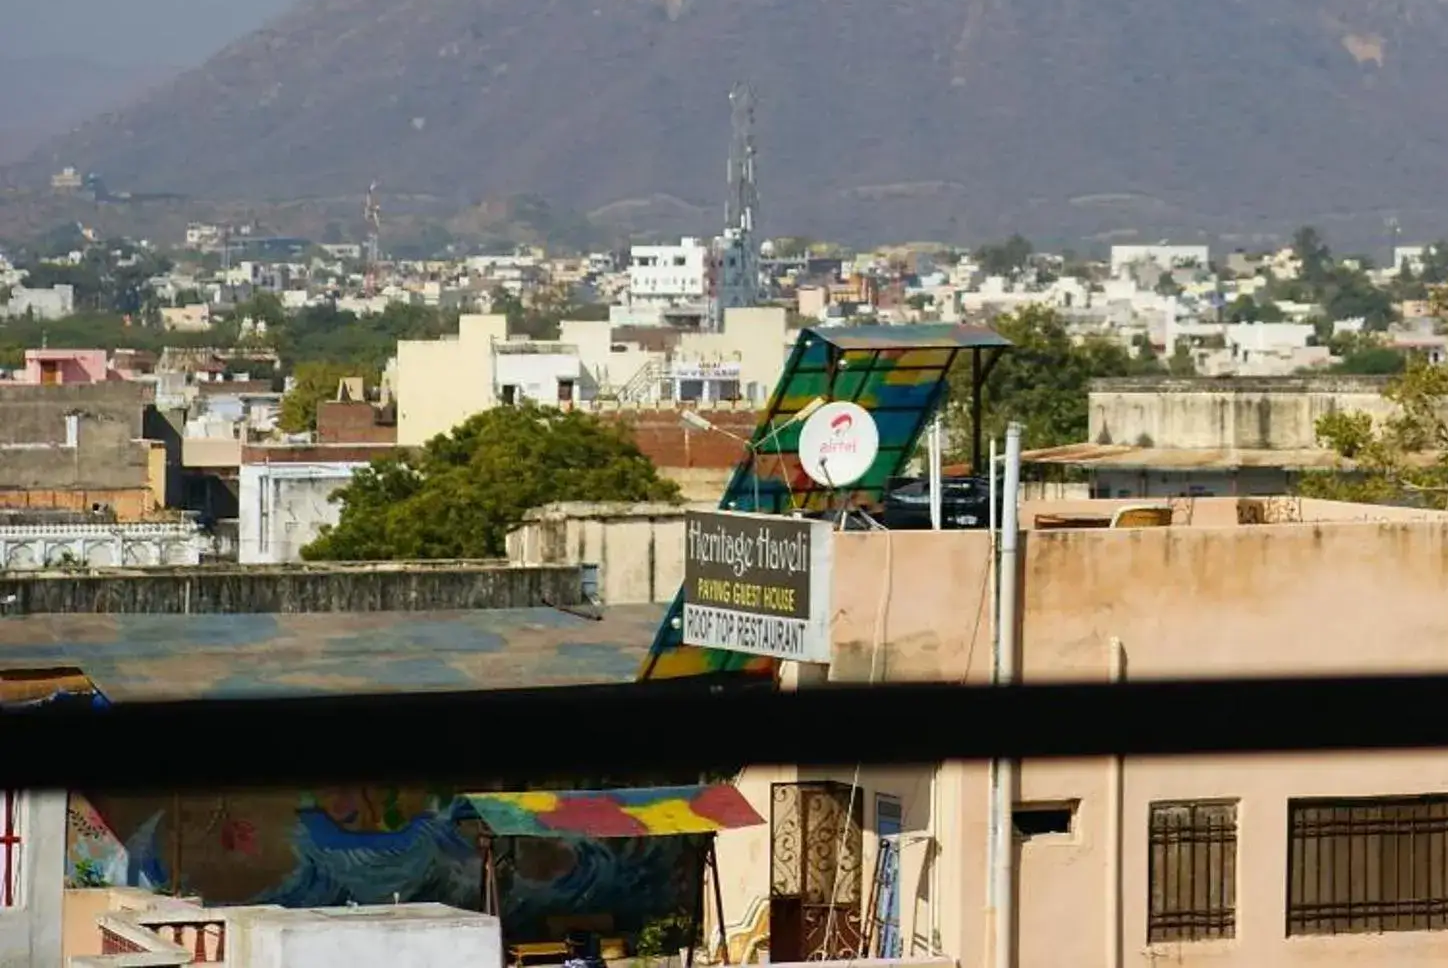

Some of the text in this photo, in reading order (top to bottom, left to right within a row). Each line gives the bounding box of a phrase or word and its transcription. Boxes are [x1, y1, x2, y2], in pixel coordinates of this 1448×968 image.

[819, 440, 858, 455] airtel
[688, 519, 807, 577] Heritage Haveli
[698, 578, 796, 612] PAYING GUEST HOUSE
[687, 607, 806, 654] ROOF TOP RESTAURANT
